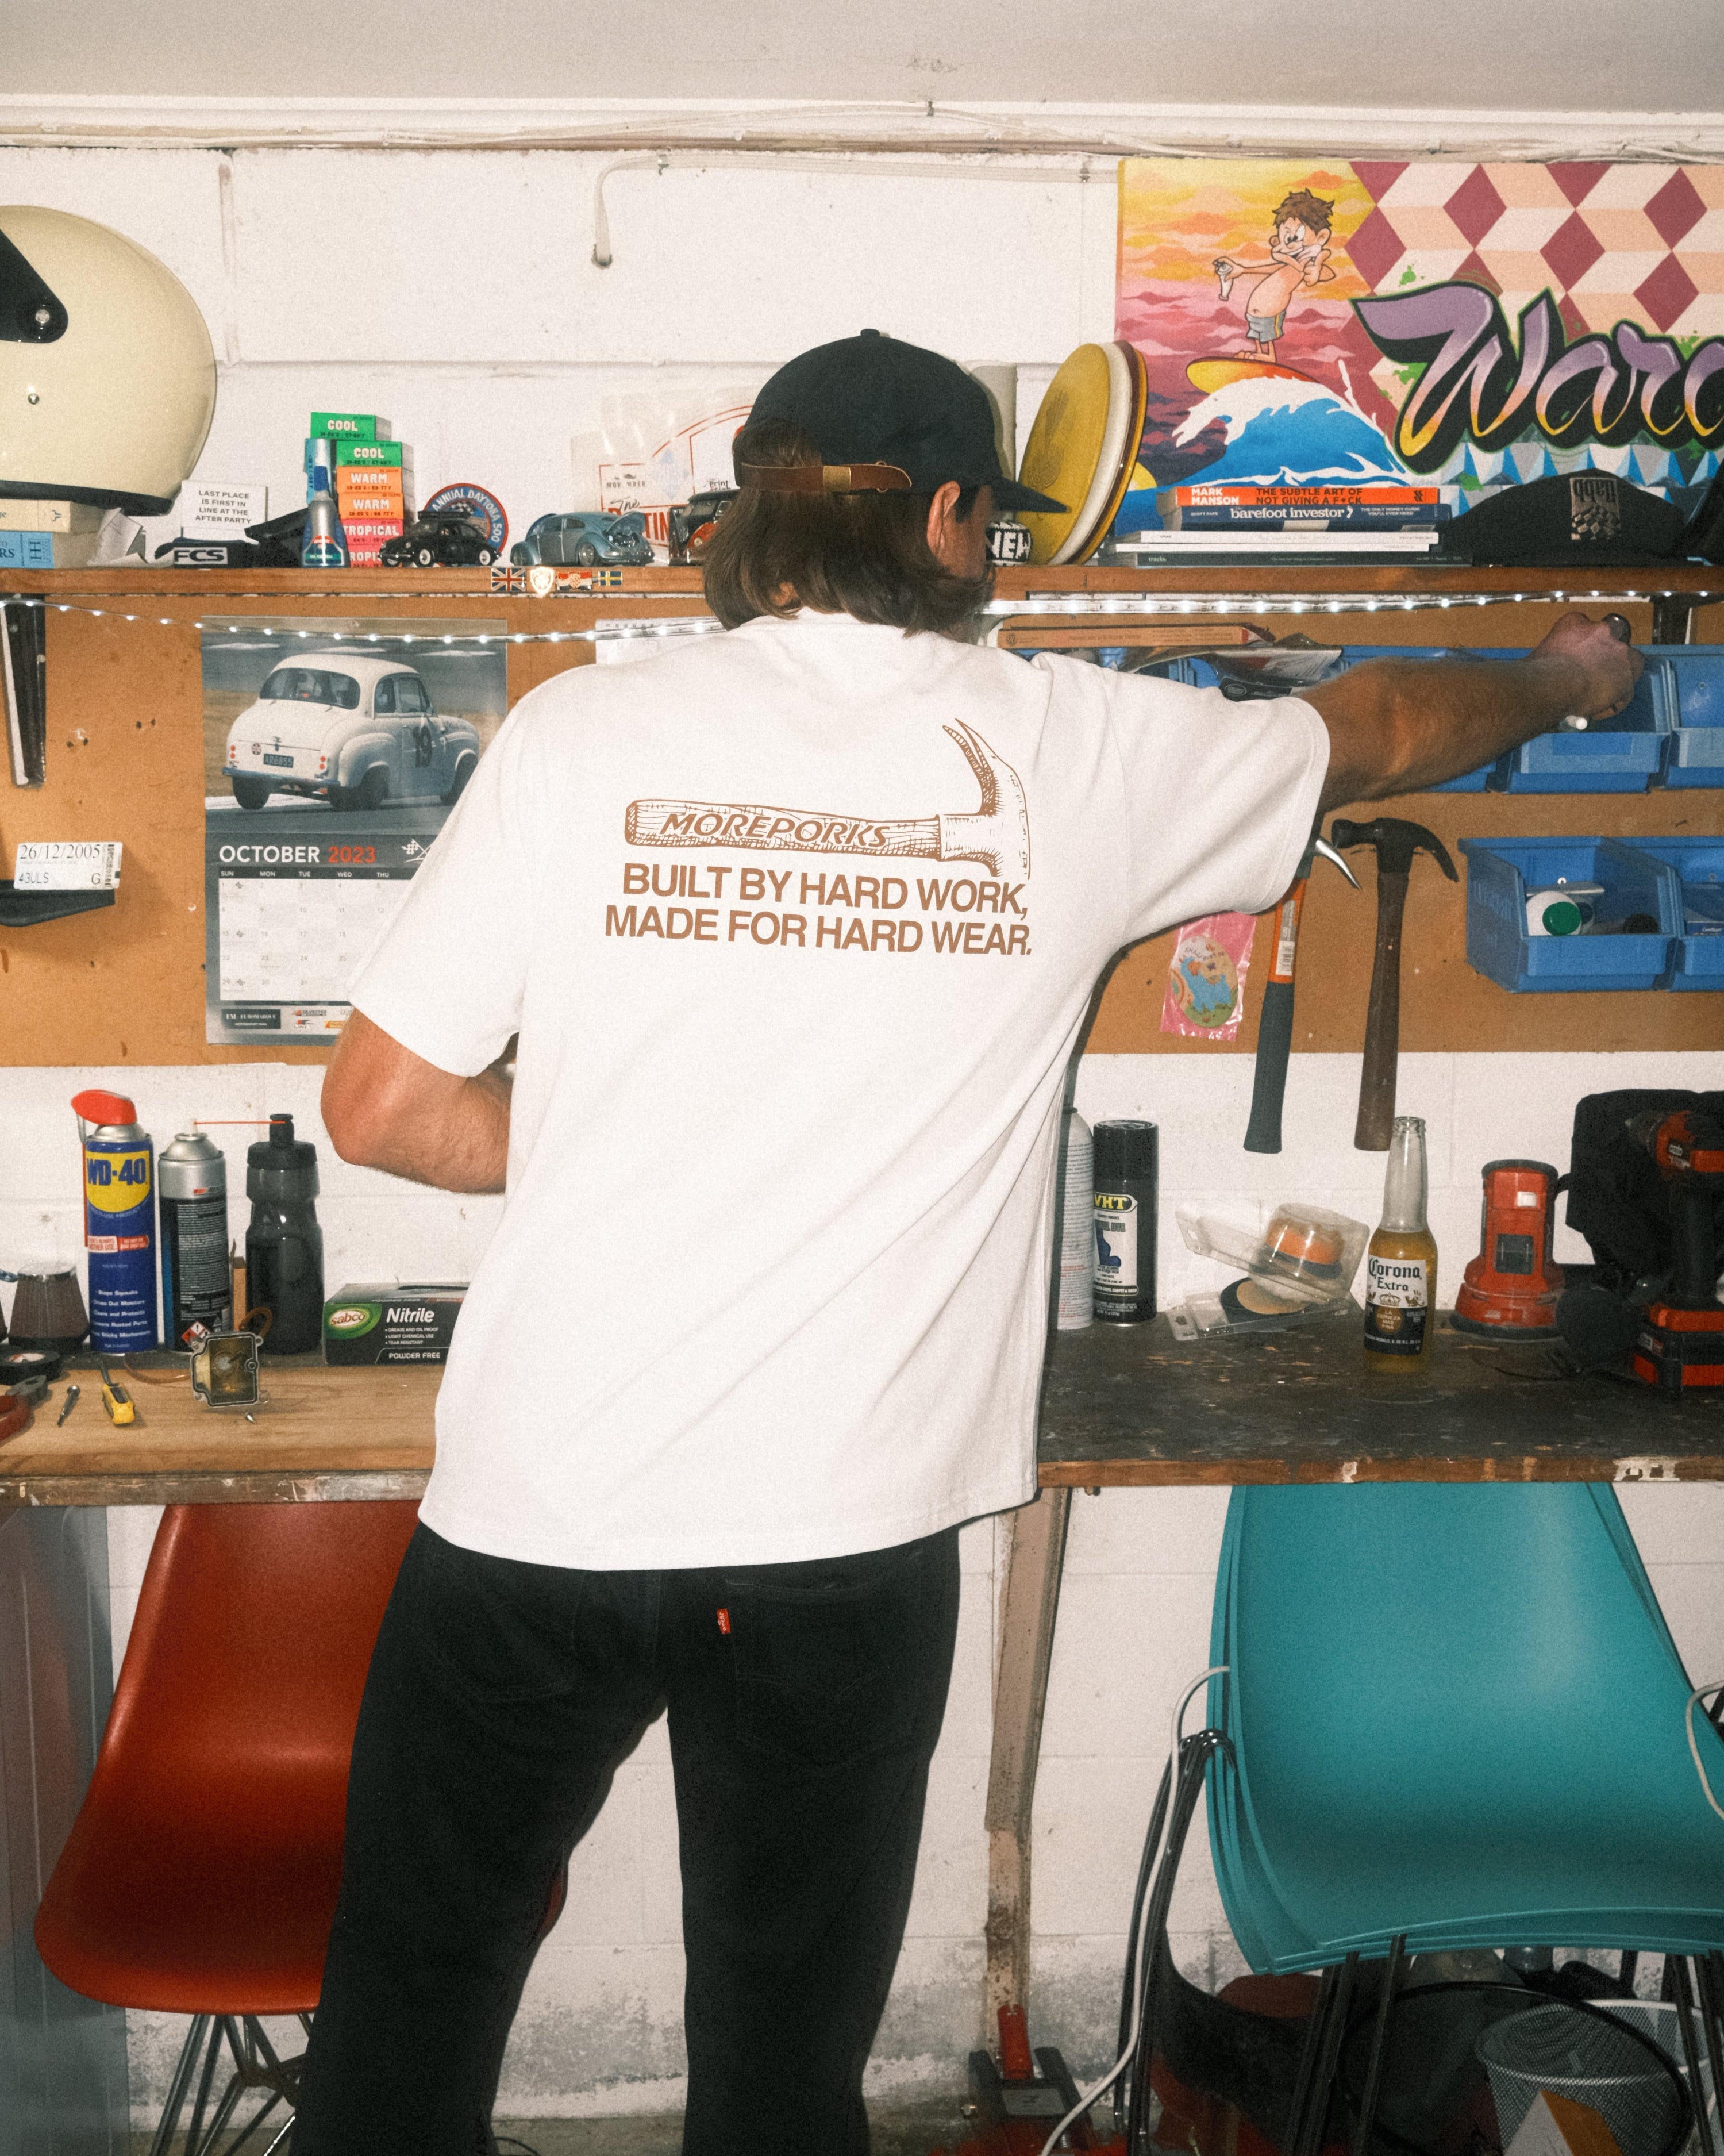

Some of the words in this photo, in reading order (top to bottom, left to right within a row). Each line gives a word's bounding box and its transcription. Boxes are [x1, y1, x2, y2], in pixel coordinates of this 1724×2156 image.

[327, 420, 359, 431] COOL
[353, 448, 384, 458] COOL
[351, 473, 387, 483] WARM
[1191, 487, 1223, 496] MARK
[353, 499, 390, 509] WARM
[1191, 497, 1240, 505] MANSON
[432, 489, 465, 511] ANNUAL
[467, 490, 501, 522] DAYTONA
[491, 522, 503, 543] 500
[1230, 508, 1287, 518] barefoot
[1290, 508, 1345, 518] investor
[343, 525, 400, 536] TROPICAL
[174, 550, 225, 562] FCS
[659, 812, 890, 848] MOREPORKS
[20, 844, 100, 860] 26/12/2005
[219, 845, 320, 863] OCTOBER
[328, 846, 376, 864] 2023
[19, 872, 49, 883] 43ULS
[91, 873, 101, 884] G
[622, 863, 732, 898] BUILT
[740, 868, 792, 904] BY
[799, 873, 908, 909] HARD
[917, 878, 1028, 920] WORK,
[605, 905, 718, 941] MADE
[728, 910, 806, 947] FOR
[816, 916, 923, 952] HARD
[932, 921, 1032, 955] WEAR.
[1094, 1194, 1129, 1210] VHT
[1369, 1258, 1421, 1279] Corona
[1377, 1277, 1409, 1292] Extra
[330, 1313, 366, 1325] sabco
[386, 1308, 435, 1323] Nitrile
